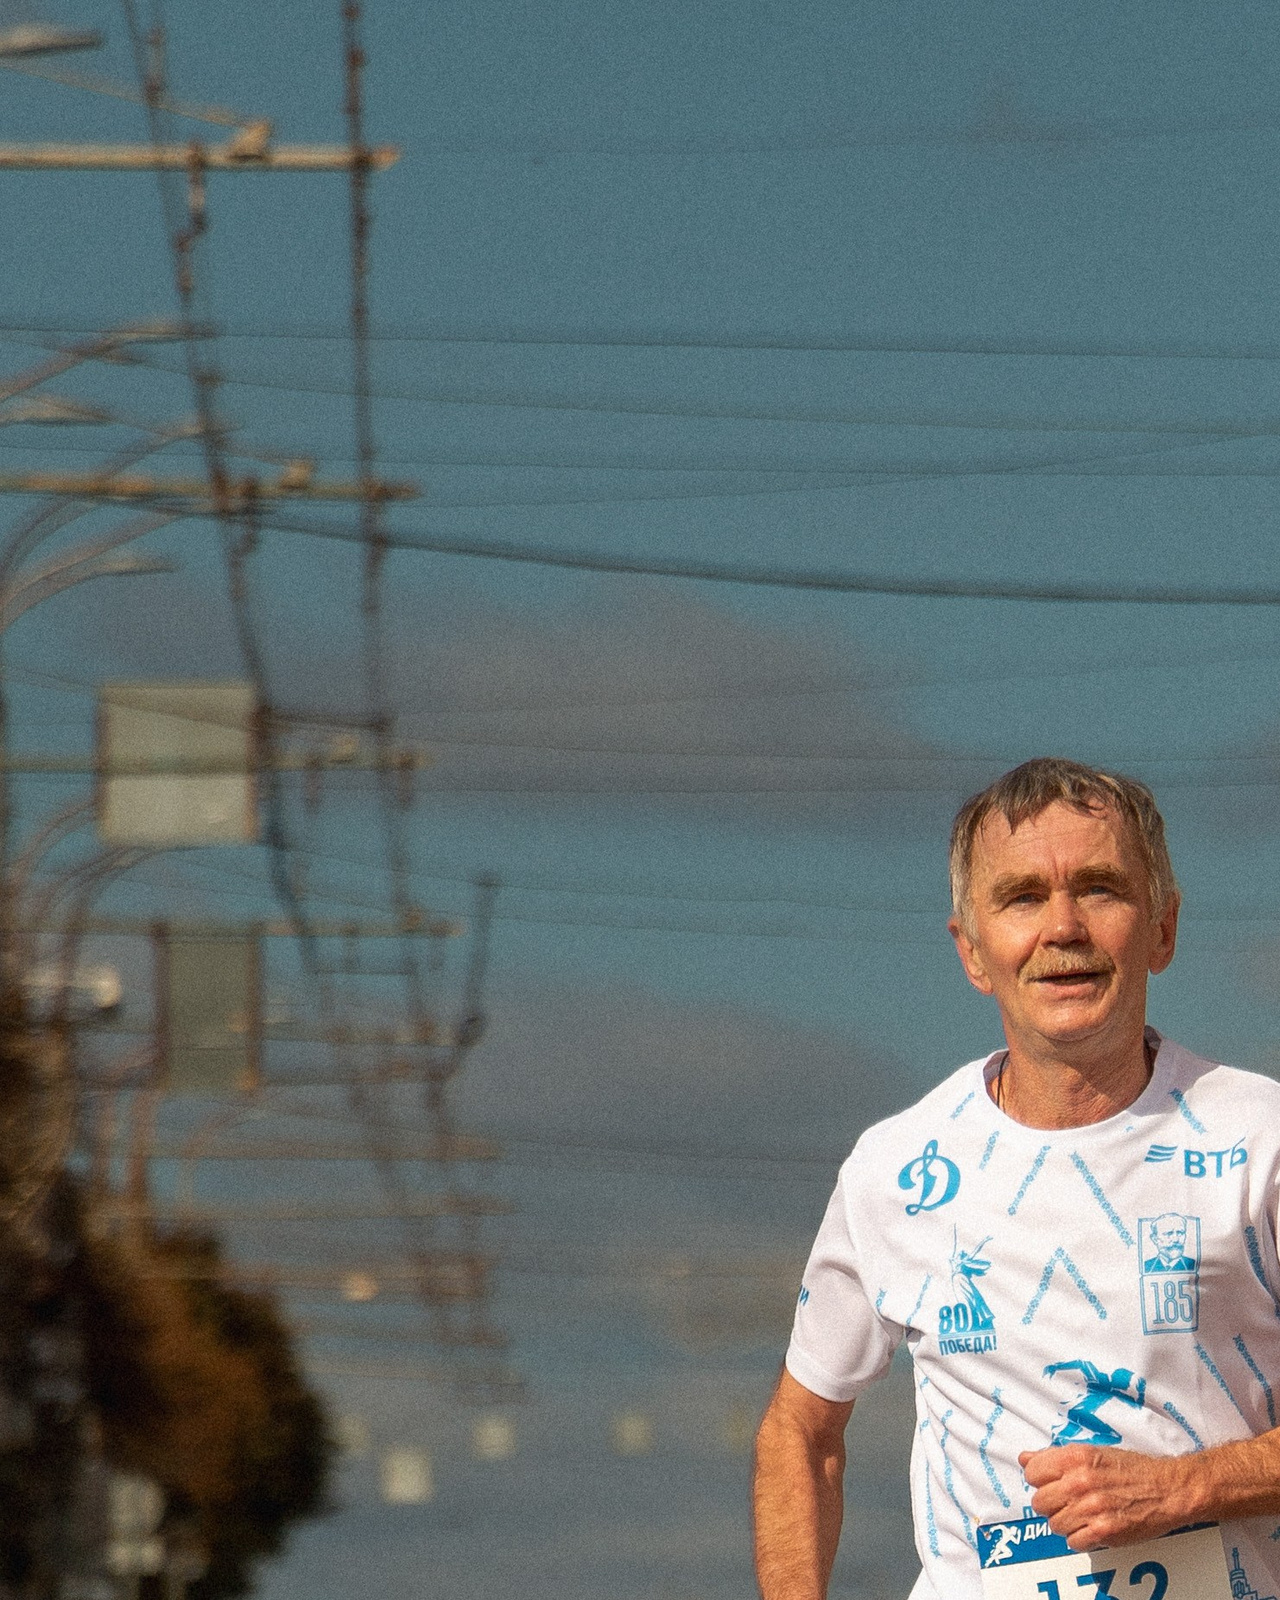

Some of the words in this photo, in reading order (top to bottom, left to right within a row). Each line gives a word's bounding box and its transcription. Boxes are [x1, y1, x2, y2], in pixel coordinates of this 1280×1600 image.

[1184, 1137, 1248, 1178] ВТБ
[938, 1303, 968, 1335] 80
[1151, 1281, 1194, 1324] 185
[938, 1334, 998, 1356] ПОБЕДА!
